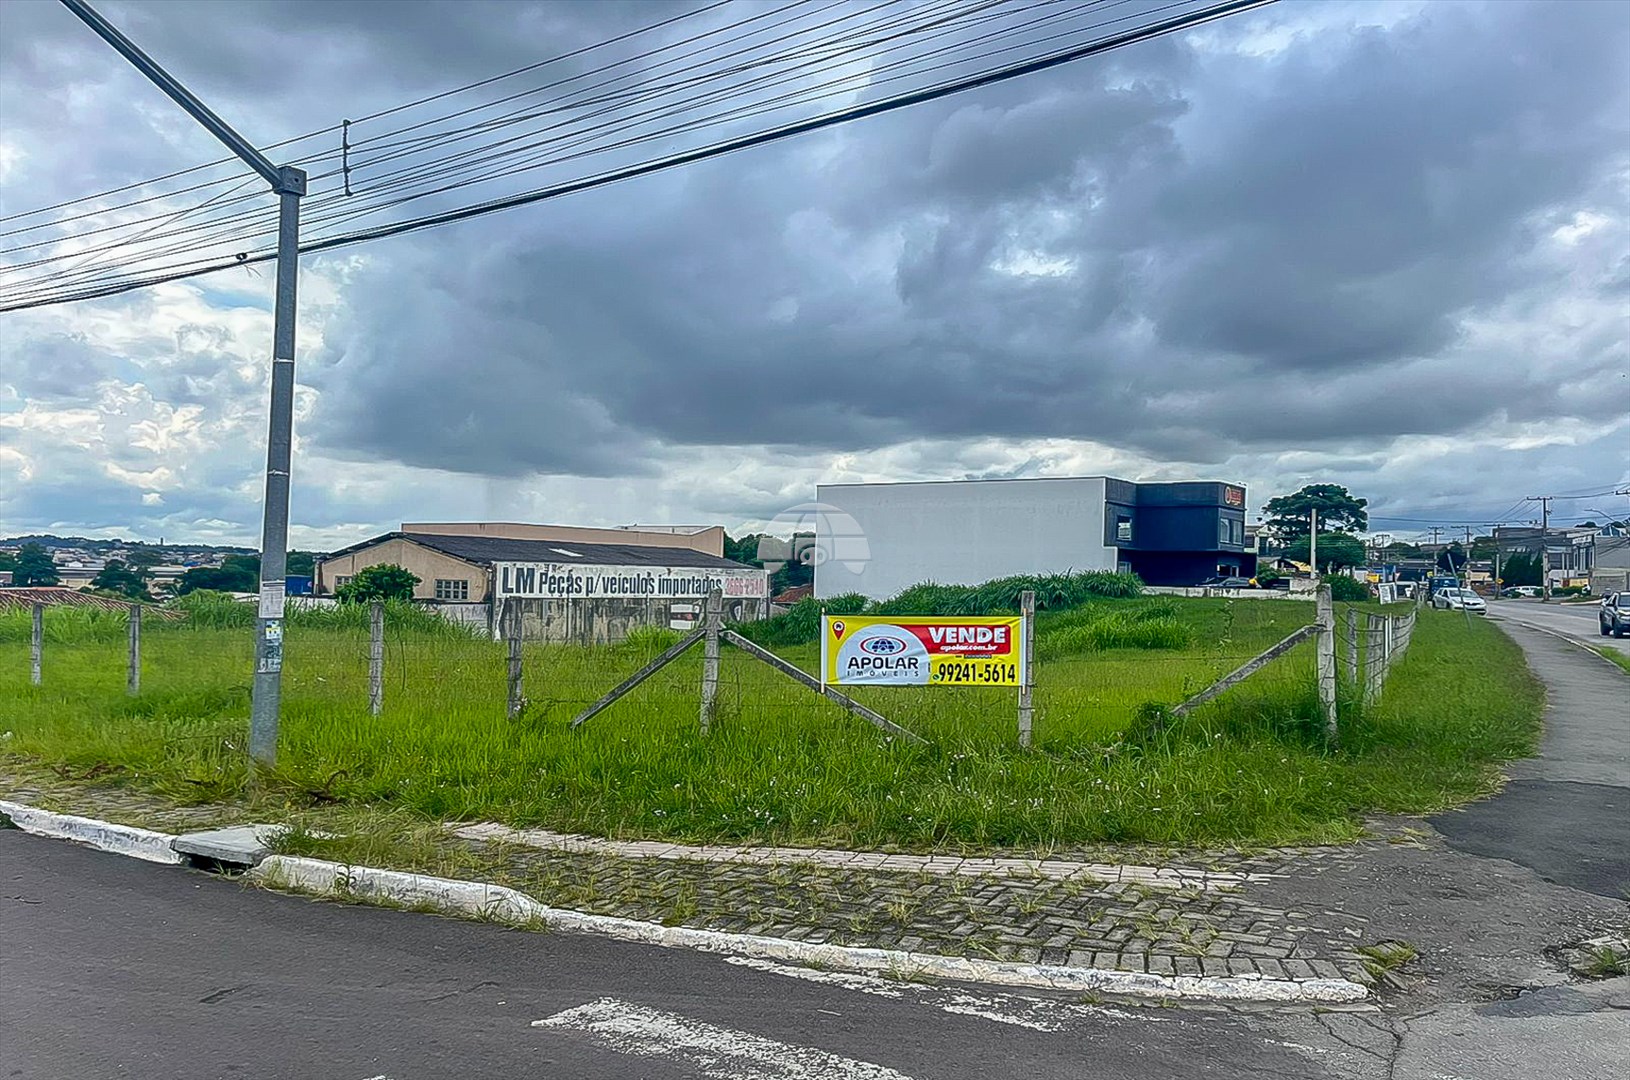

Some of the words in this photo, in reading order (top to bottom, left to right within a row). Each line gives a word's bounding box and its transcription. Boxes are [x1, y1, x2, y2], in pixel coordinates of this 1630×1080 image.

[502, 566, 535, 594] LM
[539, 569, 582, 597] Peças
[586, 573, 601, 597] p/
[602, 573, 655, 594] veículos
[658, 575, 722, 596] importados
[928, 627, 1006, 643] VENDE
[940, 644, 998, 652] apolar.com.br
[848, 657, 918, 669] APOLAR
[939, 663, 1015, 682] 99241-5614
